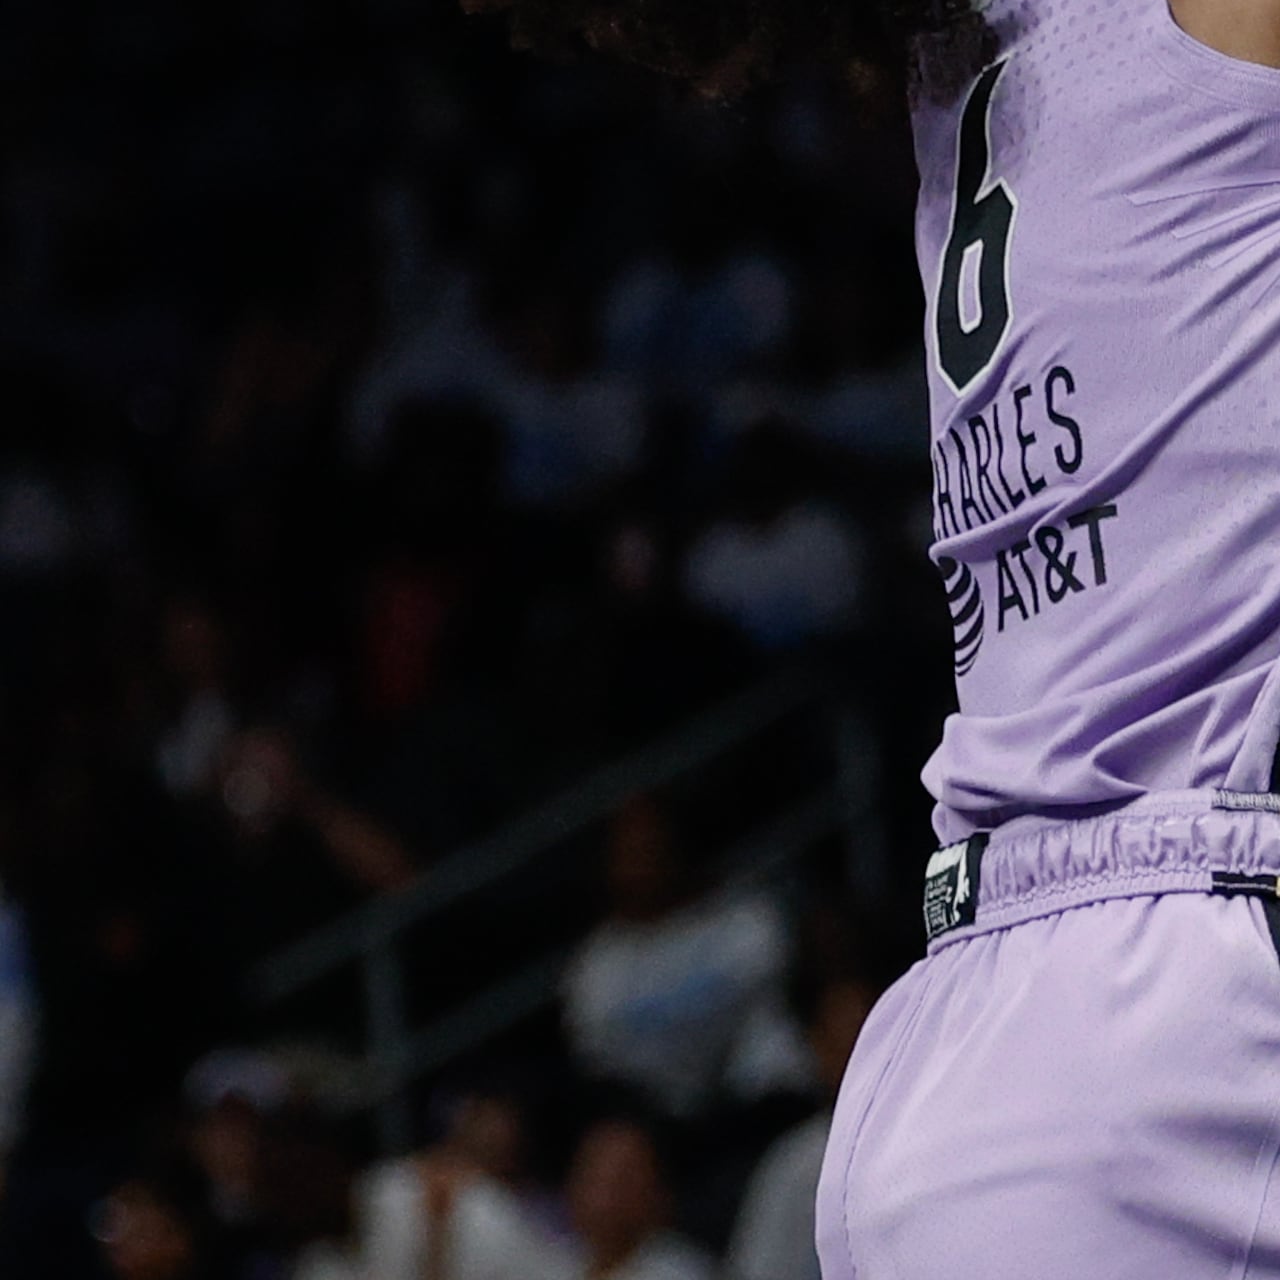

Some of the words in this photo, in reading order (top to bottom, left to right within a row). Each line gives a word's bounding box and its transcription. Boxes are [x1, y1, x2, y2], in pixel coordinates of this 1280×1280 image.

[935, 54, 1019, 397] 6
[934, 365, 1084, 540] HARLES
[997, 504, 1118, 633] AT&T
